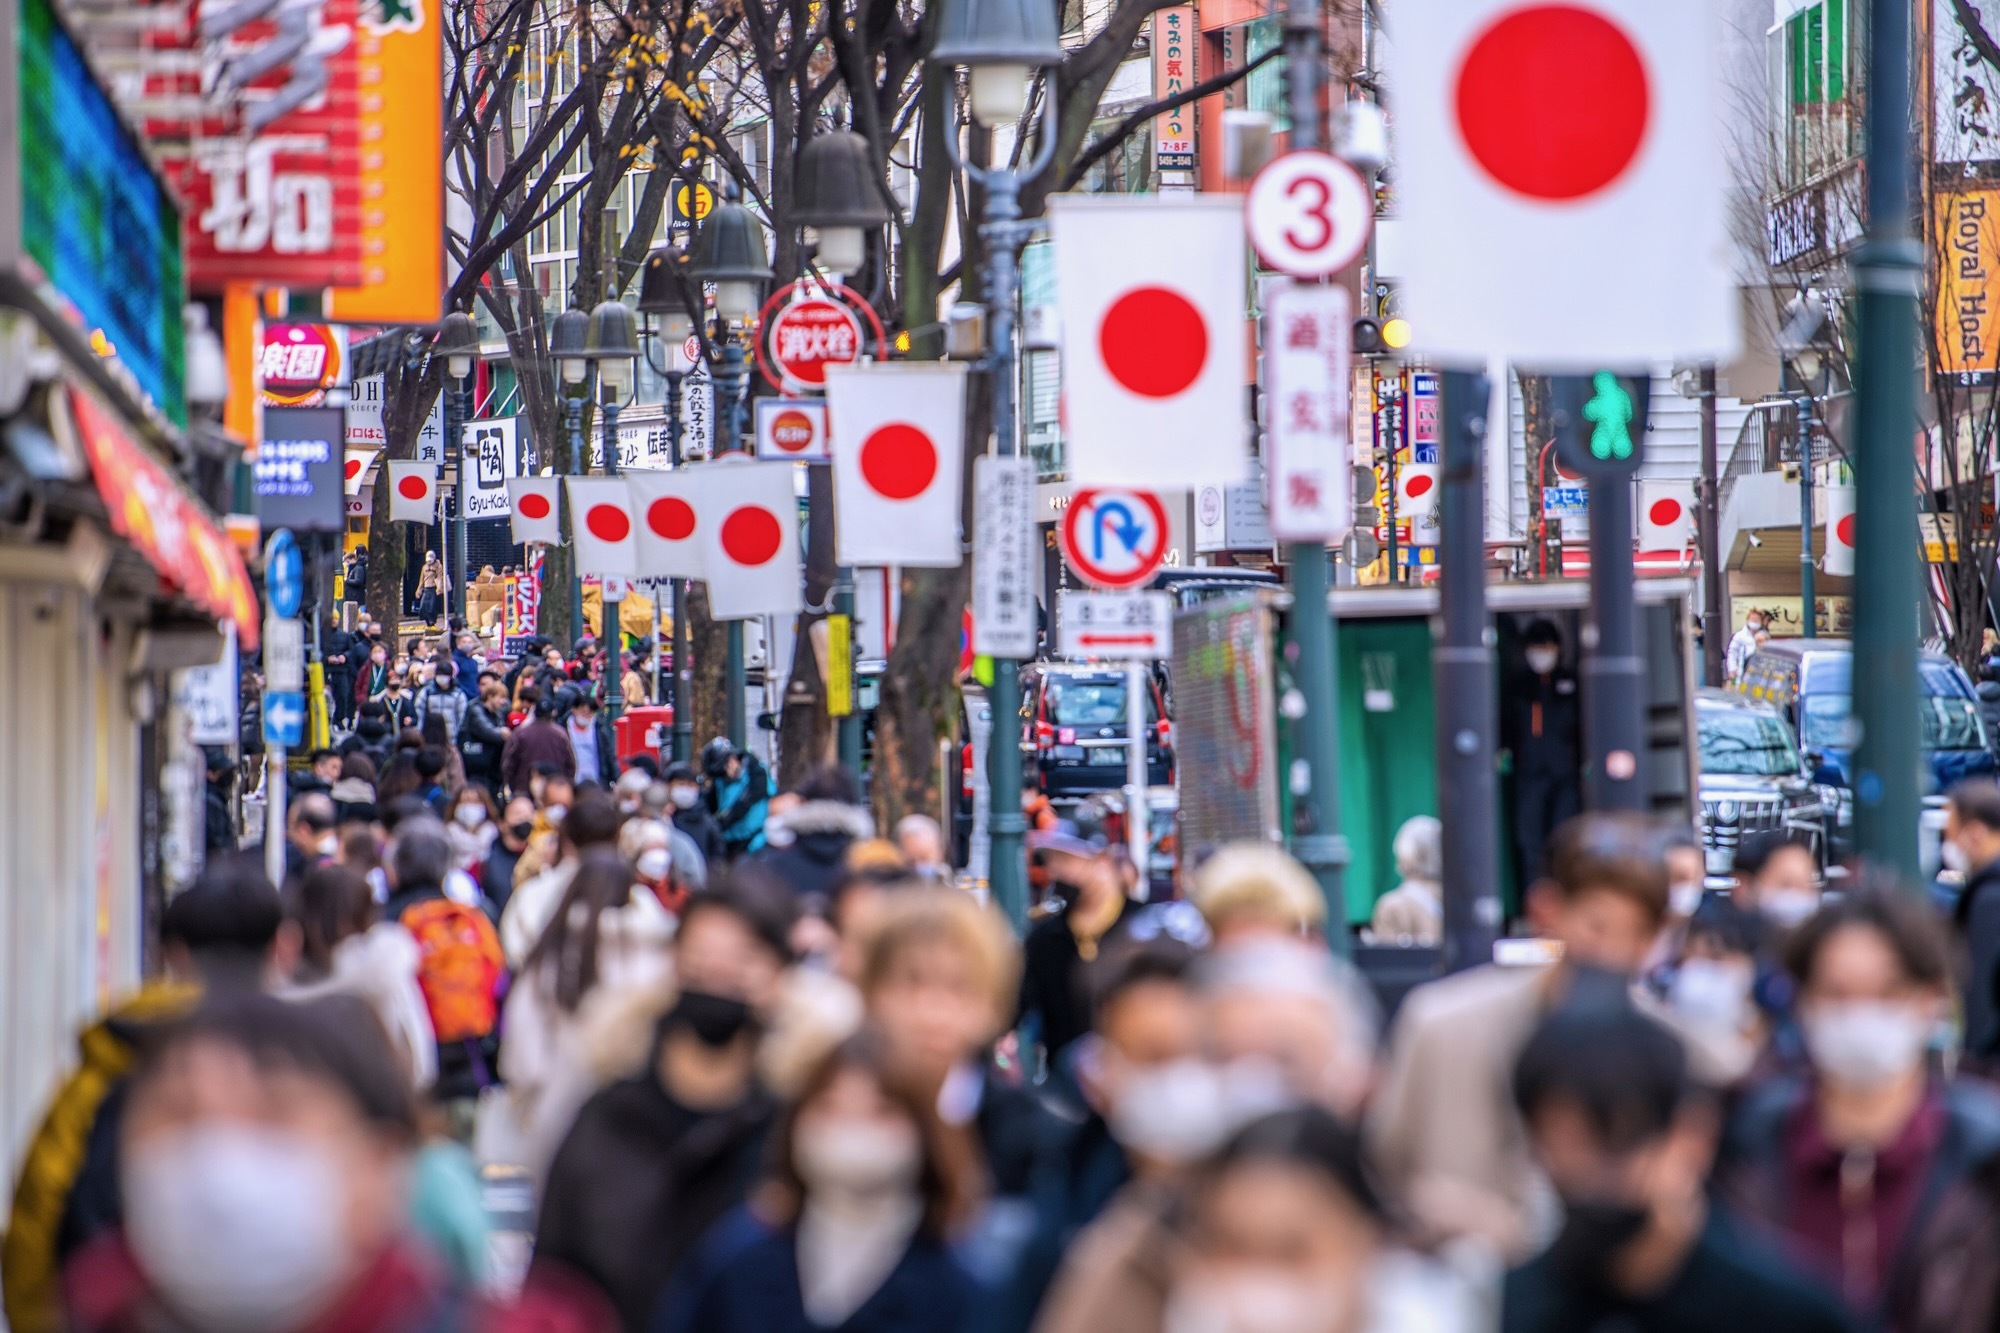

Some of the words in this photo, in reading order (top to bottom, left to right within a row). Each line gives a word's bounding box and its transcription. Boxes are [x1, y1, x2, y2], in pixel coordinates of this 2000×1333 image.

[1285, 176, 1333, 253] 3
[1953, 197, 1986, 281] Royal
[779, 323, 854, 363] 消火栓
[1958, 290, 1987, 362] Host
[258, 341, 327, 381] 楽園
[481, 440, 502, 475] 牛角
[468, 493, 512, 514] Gyu-Kak
